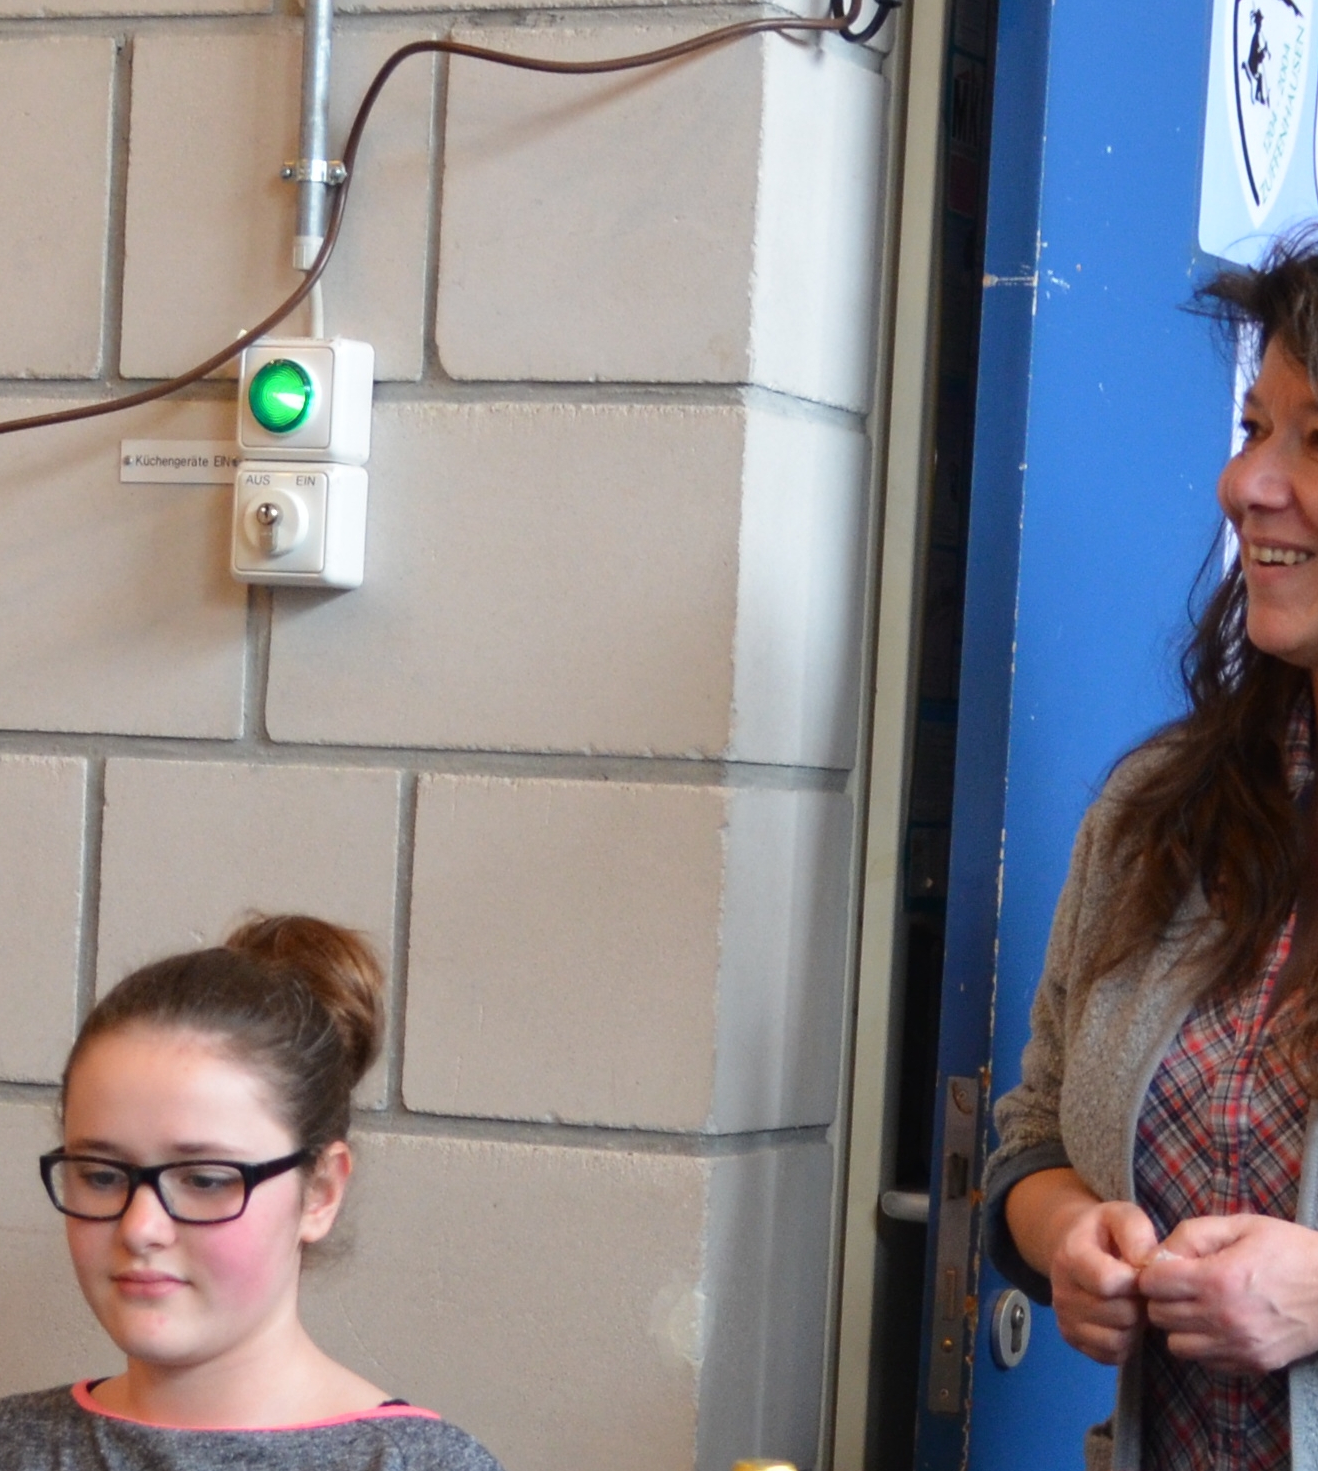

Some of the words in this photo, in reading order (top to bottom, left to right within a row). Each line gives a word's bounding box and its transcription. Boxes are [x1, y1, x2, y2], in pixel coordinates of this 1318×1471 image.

[1260, 25, 1304, 205] ZUFFENHAUSEN
[135, 454, 209, 469] Küchengeräte
[213, 456, 230, 468] EIN
[246, 474, 271, 486] AUS
[296, 475, 316, 486] EIN
